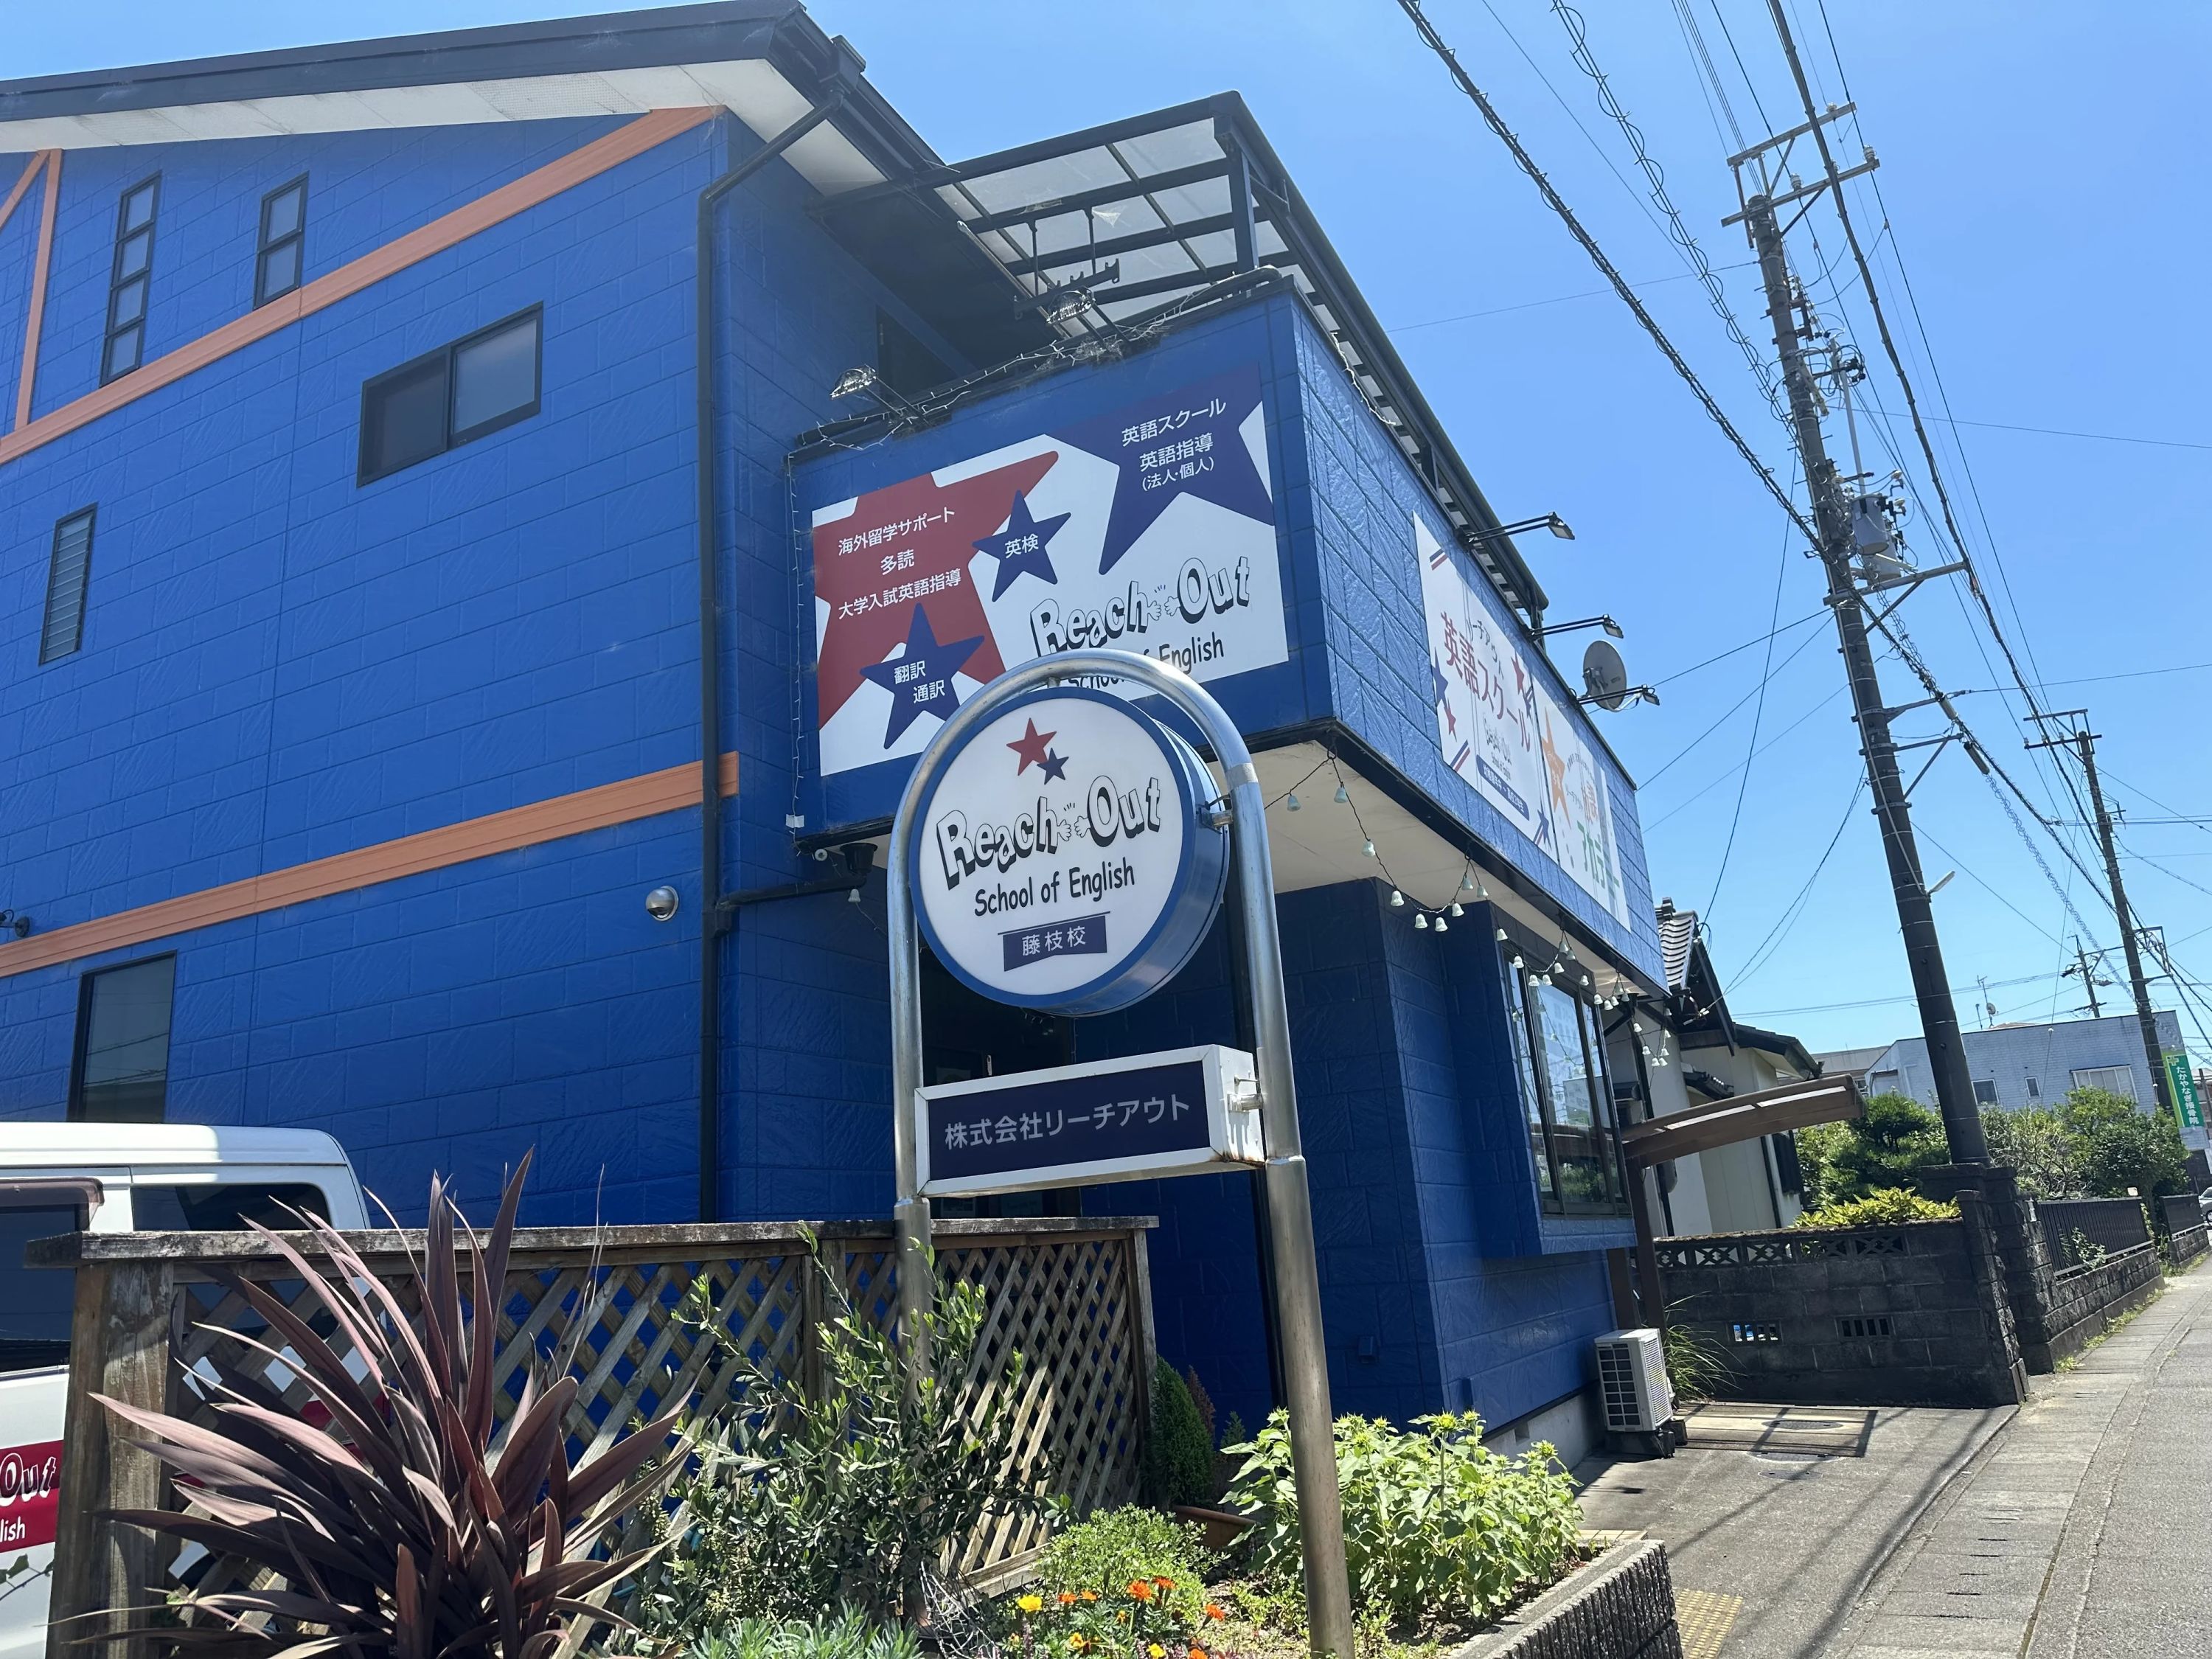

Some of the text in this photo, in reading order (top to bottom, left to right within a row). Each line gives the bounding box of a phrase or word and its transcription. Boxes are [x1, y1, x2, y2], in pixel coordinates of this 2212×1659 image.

[1120, 398, 1227, 448] 英語スクール
[1139, 431, 1214, 473] 英語指導
[838, 507, 956, 557] 海外留学サポート
[1004, 533, 1040, 559] 英検
[880, 549, 916, 577] 多読
[838, 568, 962, 621] 大学入試英語指導
[1029, 556, 1251, 658] Reach Out
[894, 660, 926, 685] 翻訳
[1158, 631, 1225, 675] English
[912, 678, 946, 704] 通訳
[1440, 610, 1531, 754] 英語スクール
[936, 775, 1161, 891] Reach Out
[1576, 819, 1621, 900] アカデミー
[974, 856, 1135, 917] School of English
[1020, 925, 1087, 958] 藤枝校
[944, 1093, 1192, 1151] 株式会社リーチアウト
[0, 1452, 57, 1507] Out
